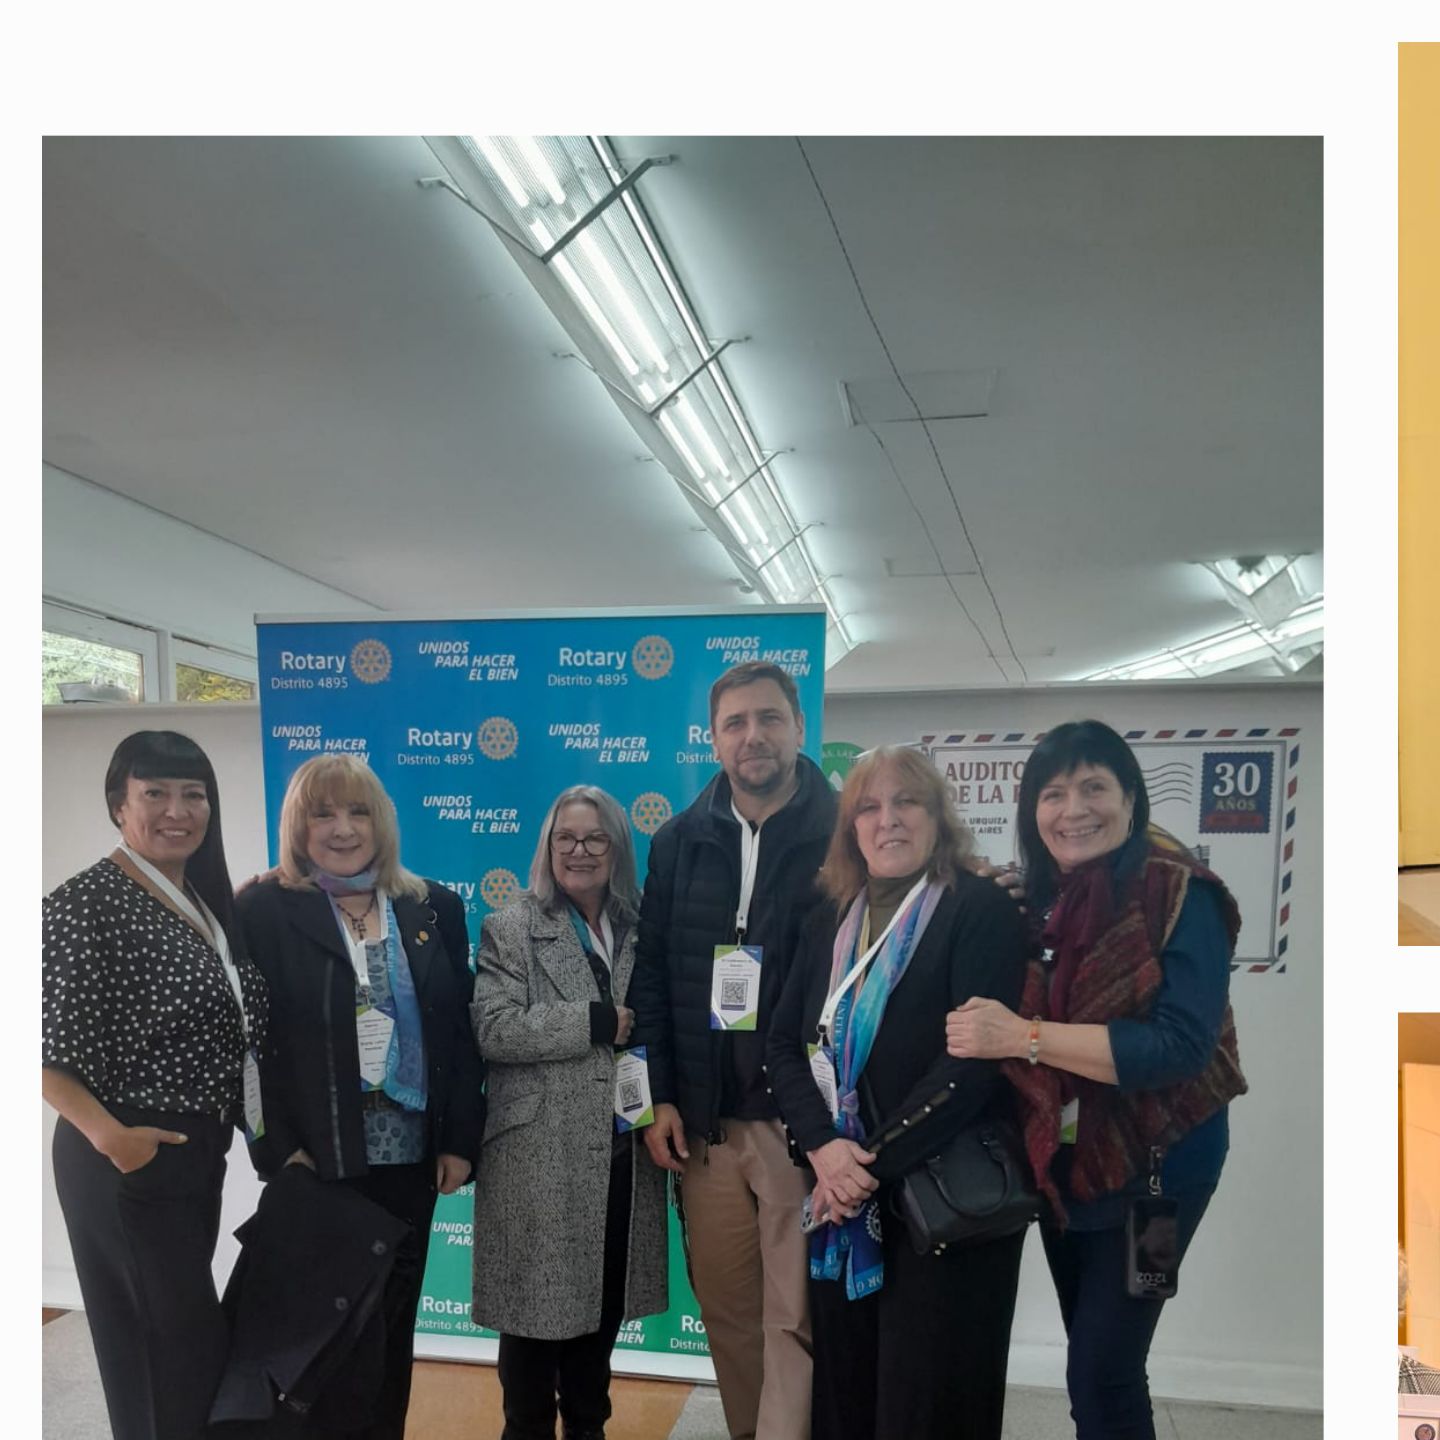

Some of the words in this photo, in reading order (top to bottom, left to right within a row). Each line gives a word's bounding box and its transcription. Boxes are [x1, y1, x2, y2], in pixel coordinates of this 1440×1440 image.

[419, 641, 469, 654] UNIDOS
[706, 636, 760, 650] UNIDOS
[281, 651, 346, 674] Rotary
[435, 654, 469, 668] PARA
[472, 654, 515, 667] HACER
[559, 647, 627, 669] Rotary
[722, 650, 758, 662] PARA
[762, 650, 808, 662] HACER
[468, 668, 483, 681] EL
[487, 668, 518, 680] BIEN
[548, 674, 592, 686] Distrito
[596, 674, 628, 686] 4895
[271, 677, 314, 689] Distrito
[317, 677, 348, 689] 4895
[272, 725, 322, 738] UNIDOS
[548, 723, 600, 735] UNIDOS
[288, 738, 322, 750] PARA
[324, 738, 367, 750] HACER
[408, 727, 472, 749] Rotary
[564, 736, 599, 748] PARA
[602, 736, 647, 749] HACER
[397, 753, 441, 765] Distrito
[444, 753, 474, 765] 4895
[599, 750, 613, 763] EL
[617, 750, 649, 762] BIEN
[945, 761, 1025, 781] AUDITO
[1213, 762, 1261, 796] 30
[977, 784, 1004, 804] LA
[423, 795, 472, 807] UNIDOS
[439, 808, 472, 820] PARA
[475, 808, 518, 820] HACER
[969, 817, 1008, 825] URQUIZA
[471, 822, 485, 834] EL
[489, 822, 520, 834] BIEN
[978, 826, 1002, 834] AIRES
[433, 1221, 473, 1233] UNIDO
[422, 1296, 471, 1315] Rotar
